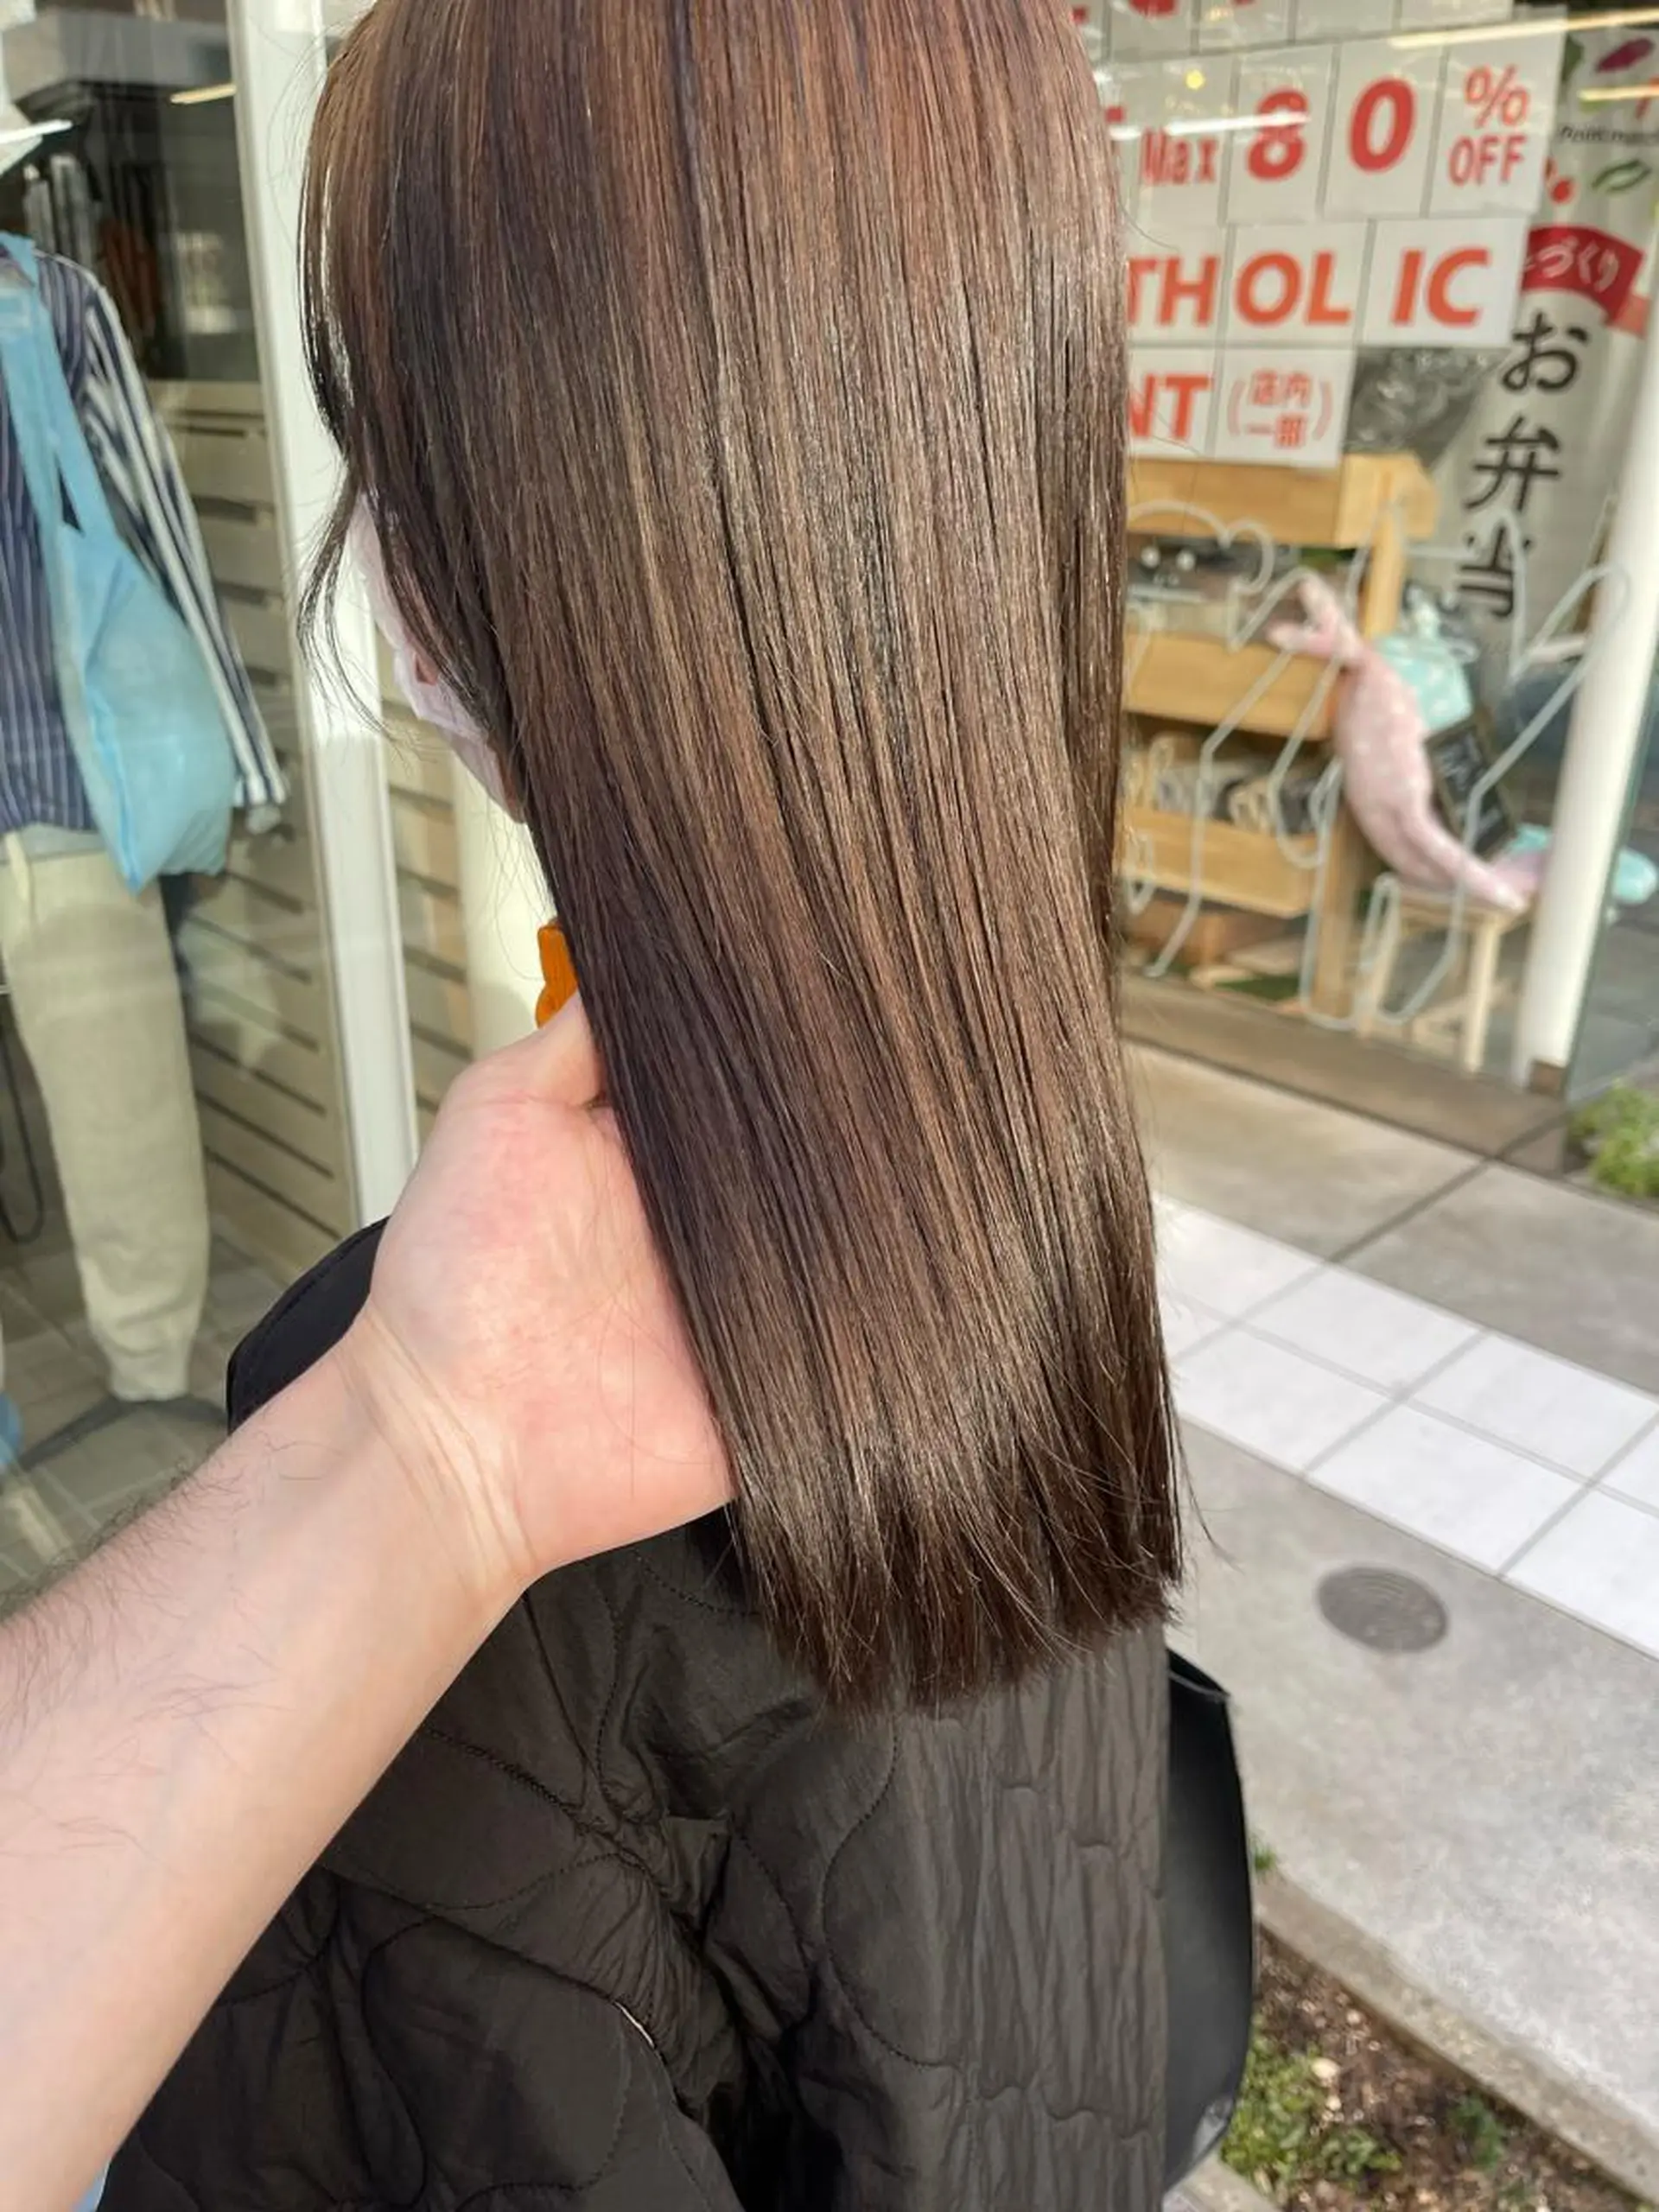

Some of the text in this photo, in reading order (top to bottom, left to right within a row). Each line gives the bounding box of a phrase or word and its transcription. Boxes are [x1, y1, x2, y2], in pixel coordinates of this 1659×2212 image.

[1139, 124, 1218, 186] Max
[1448, 135, 1528, 186] OFF
[1458, 311, 1590, 618] お弁当
